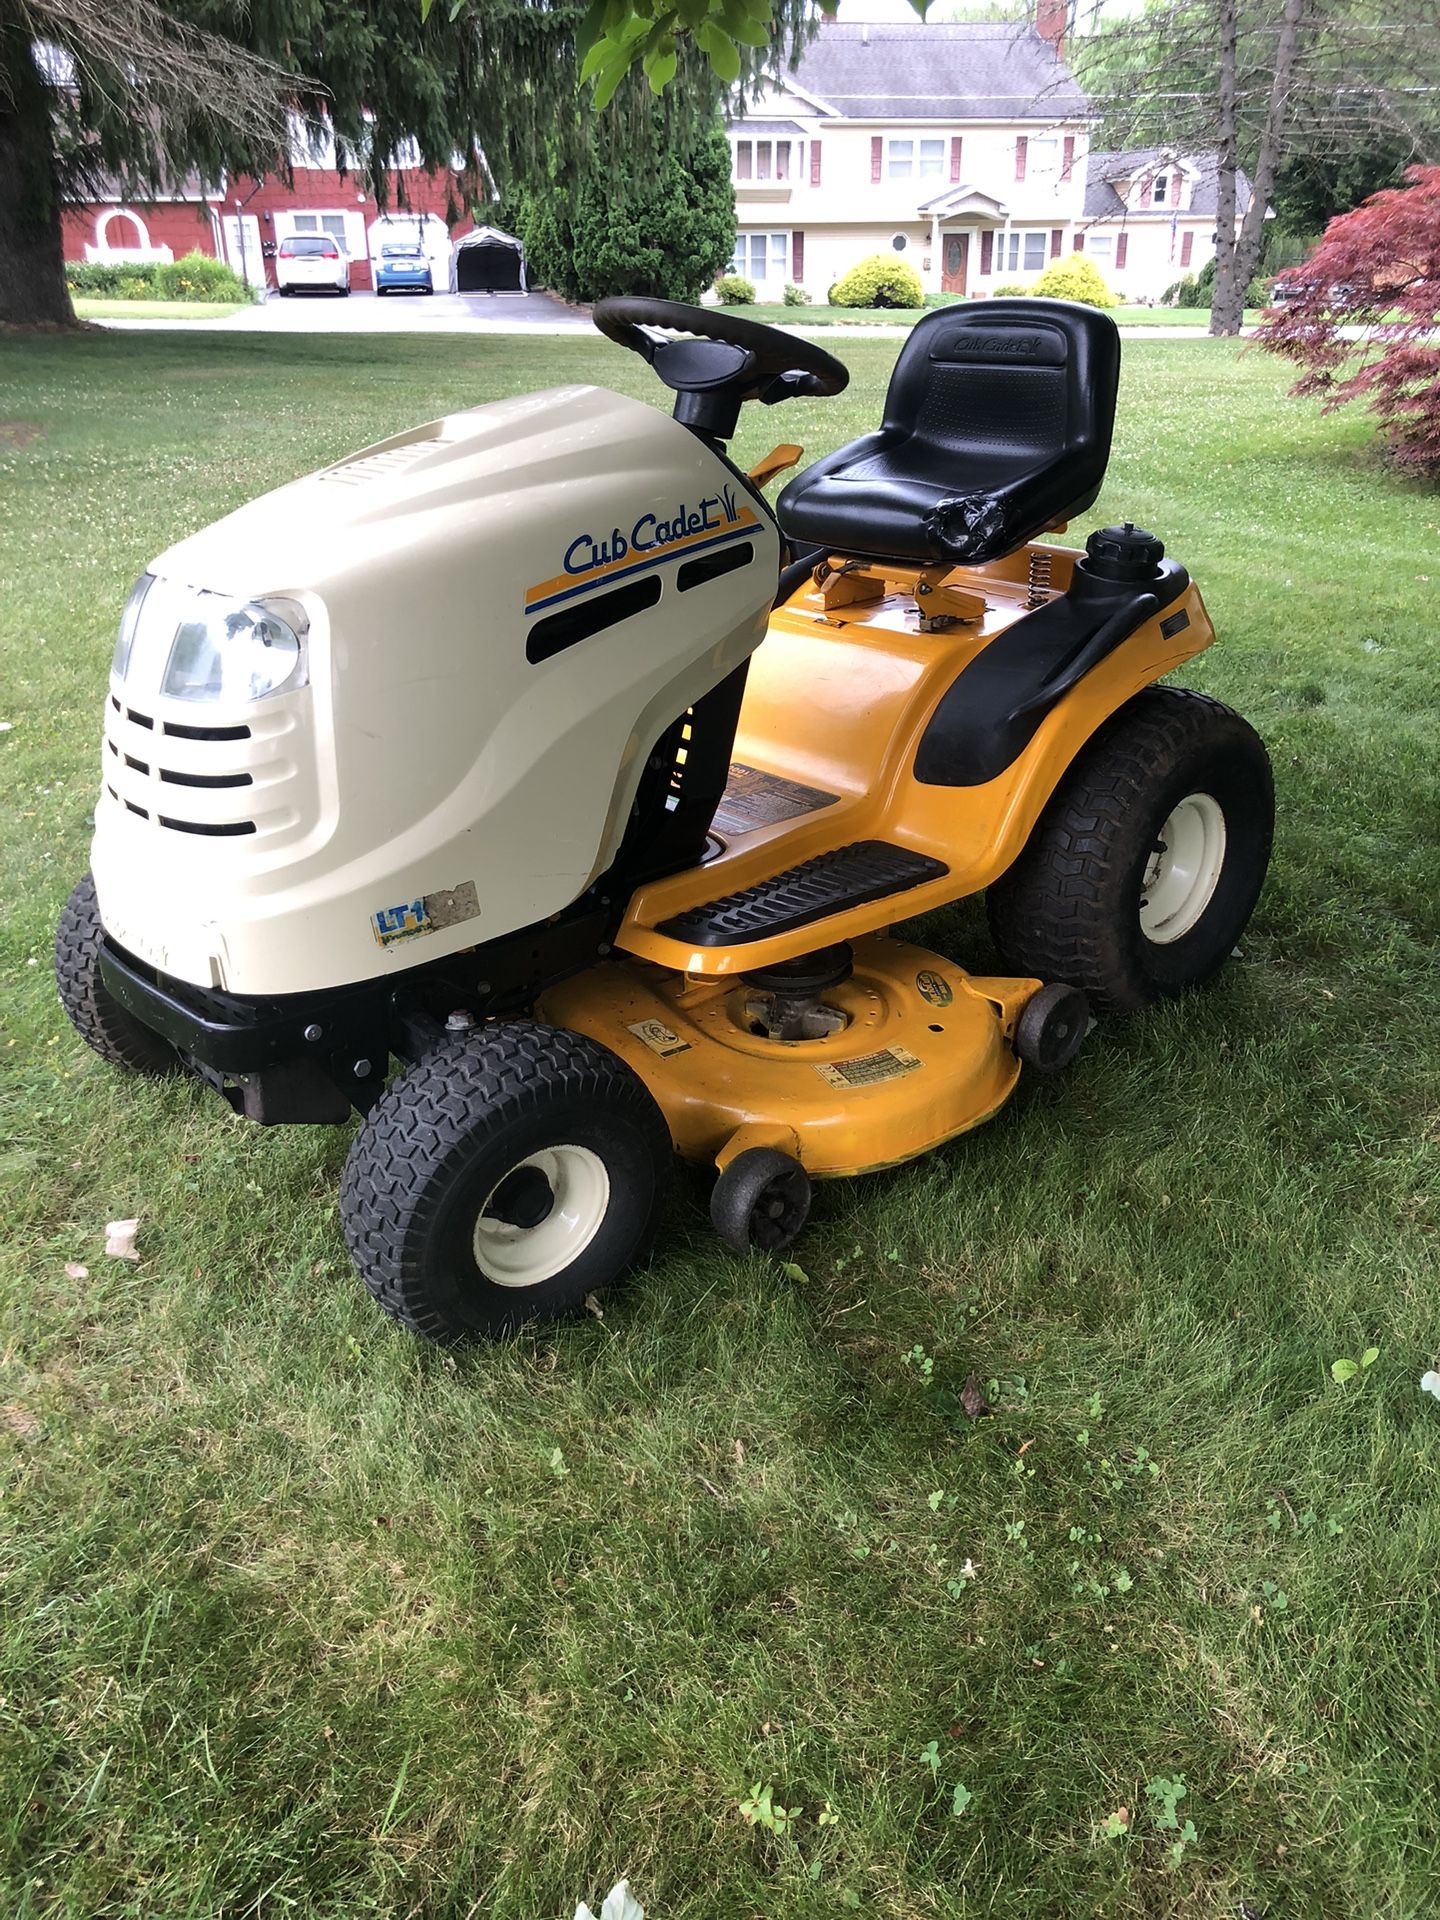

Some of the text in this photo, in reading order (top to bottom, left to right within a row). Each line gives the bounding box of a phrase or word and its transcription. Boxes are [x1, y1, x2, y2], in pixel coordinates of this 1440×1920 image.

[954, 337, 1025, 354] Cub Cadet
[563, 498, 721, 575] Cub Cadet
